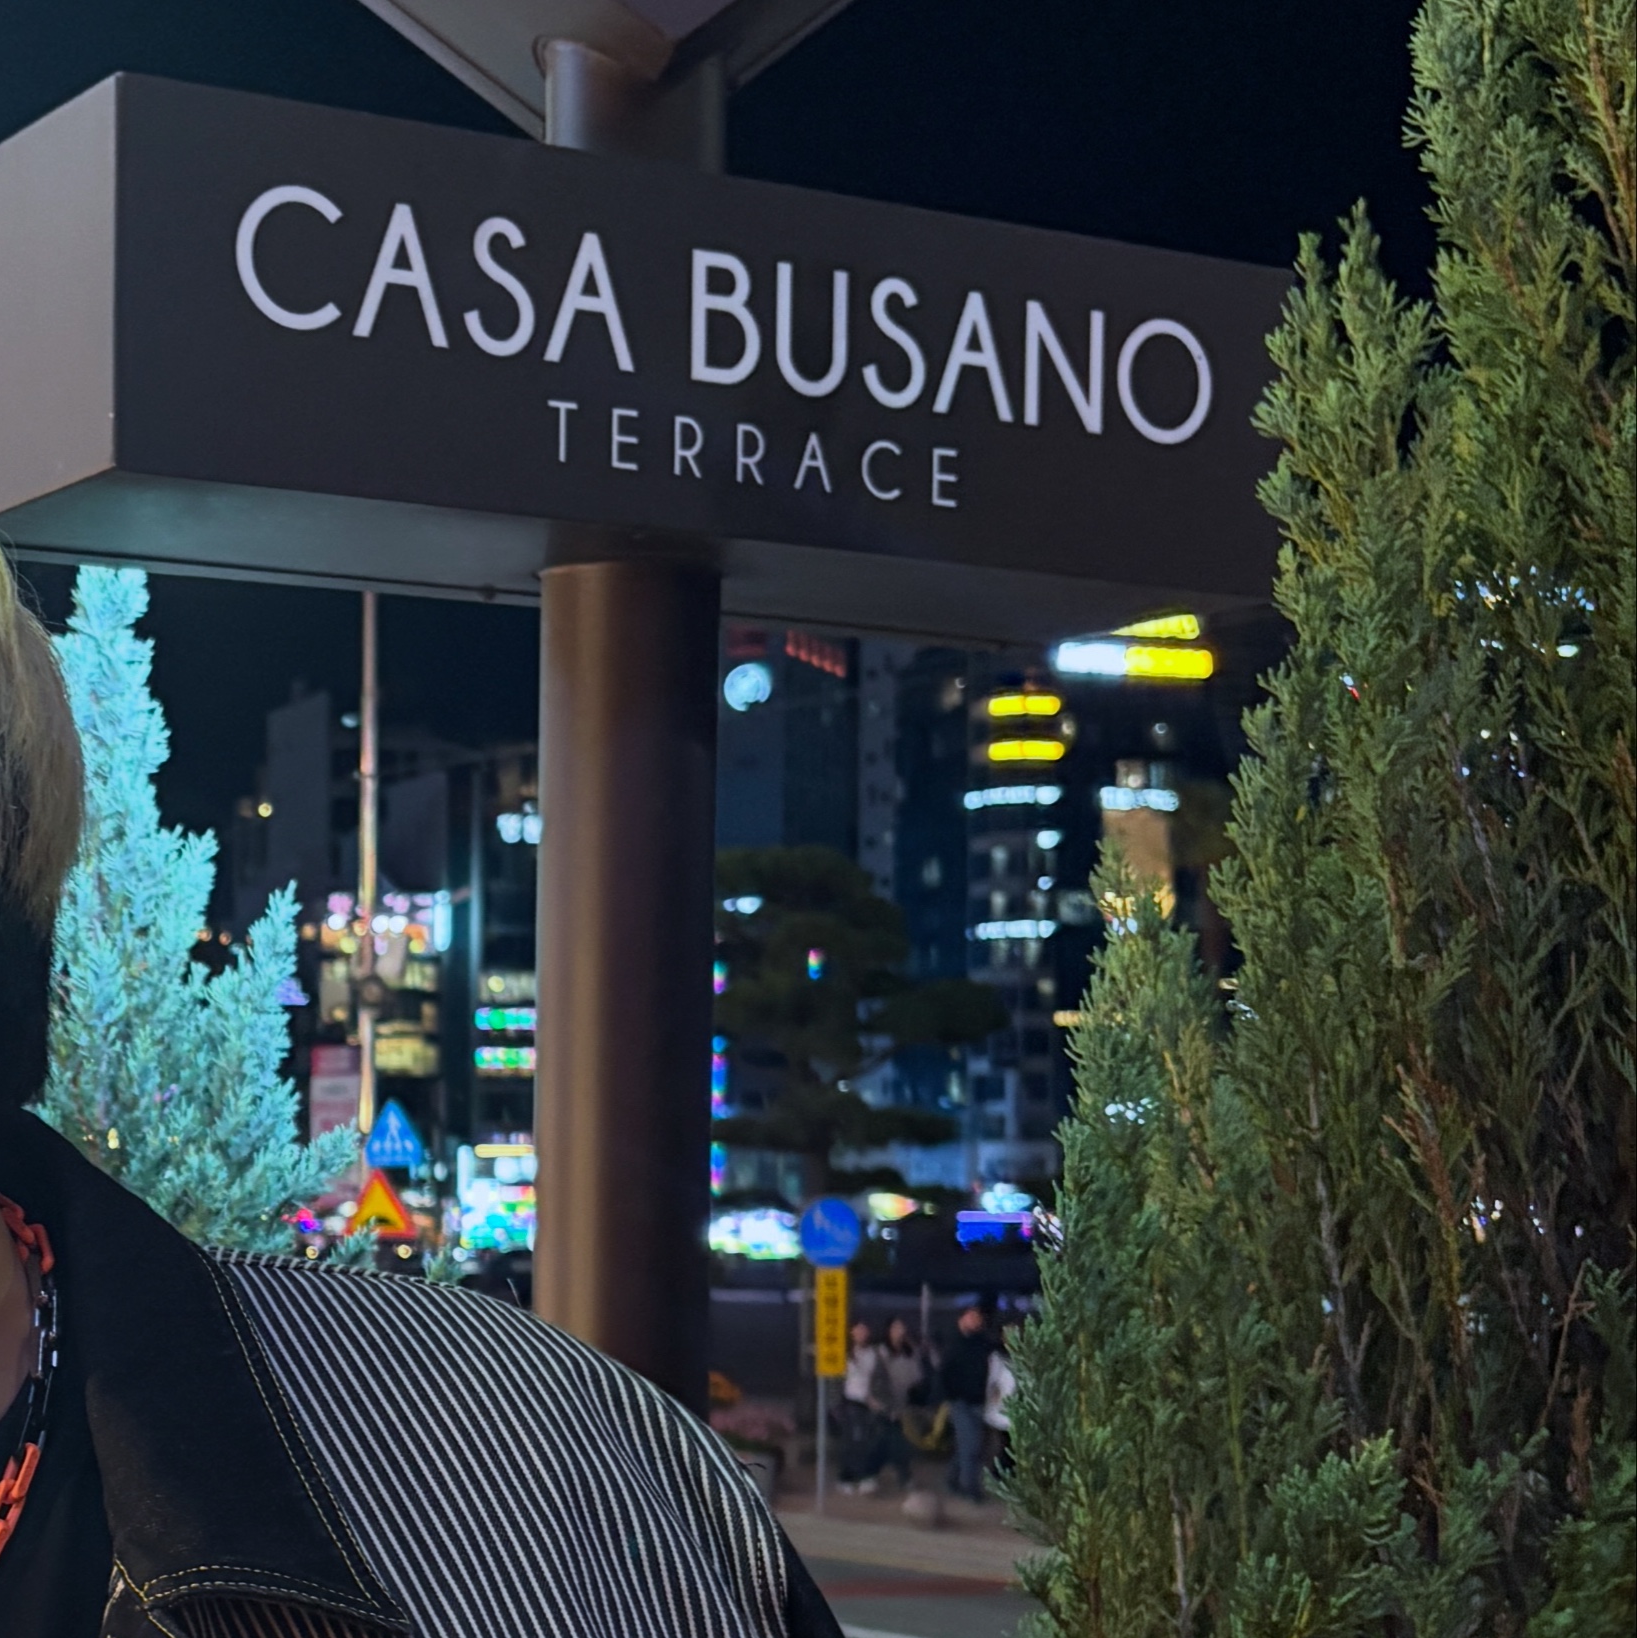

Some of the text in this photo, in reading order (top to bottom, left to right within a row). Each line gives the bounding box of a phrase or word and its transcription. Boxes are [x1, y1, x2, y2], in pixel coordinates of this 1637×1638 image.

[235, 184, 1214, 446] CASA BUSANO
[547, 400, 959, 509] TERRACE
